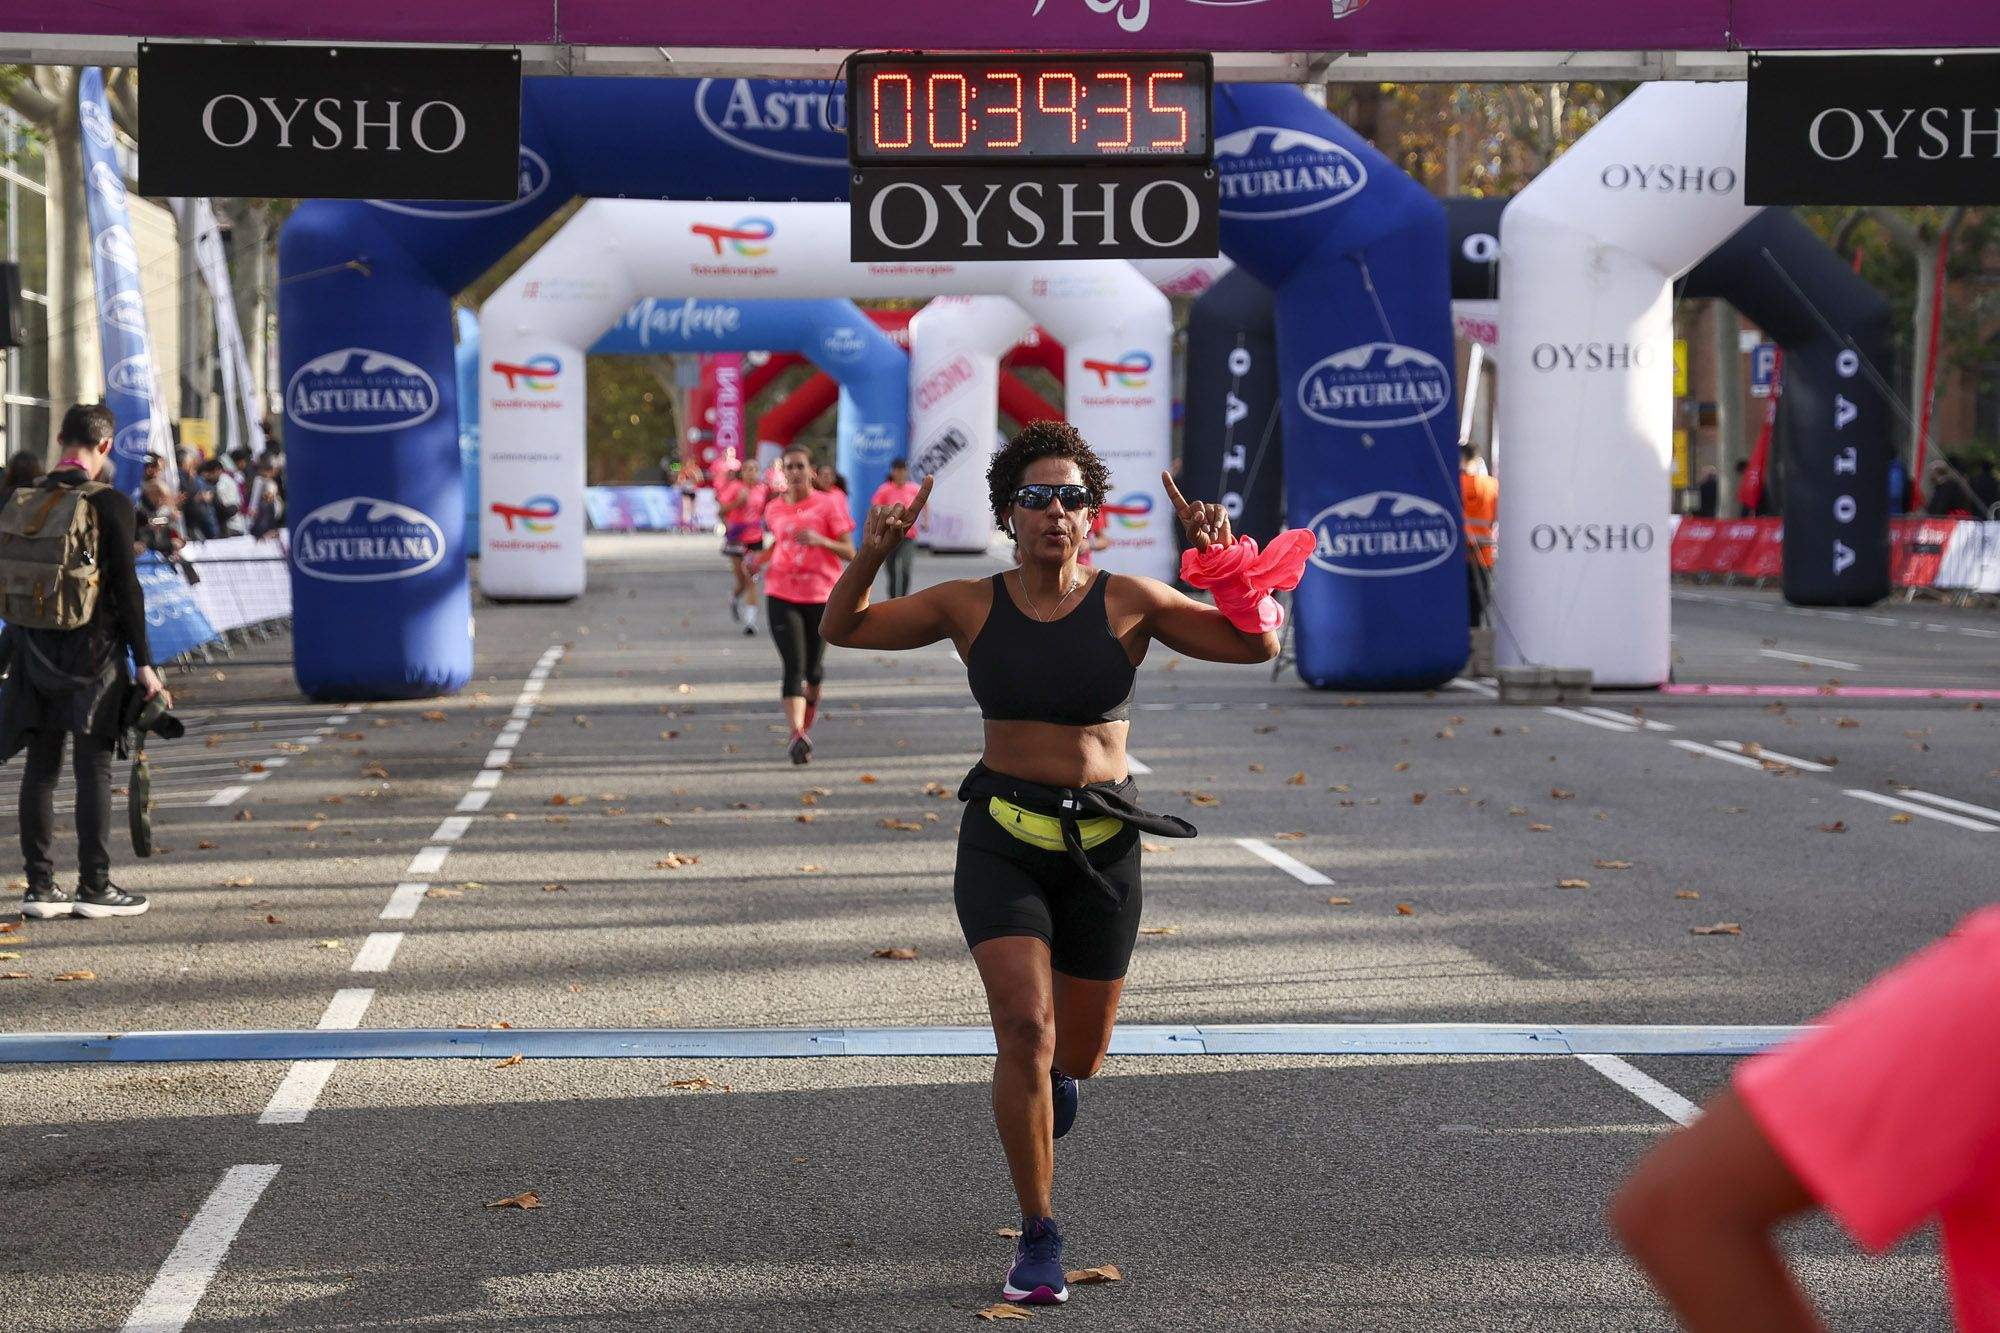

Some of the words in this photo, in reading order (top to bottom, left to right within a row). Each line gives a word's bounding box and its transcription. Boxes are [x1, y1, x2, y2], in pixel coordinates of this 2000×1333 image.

[719, 79, 847, 131] ASTU
[873, 71, 1187, 149] 00:39:35
[202, 94, 466, 153] OYSHO
[1809, 107, 2000, 160] OYSH
[1219, 164, 1354, 199] TURIANA
[1602, 164, 1737, 195] OYSHO
[869, 180, 1200, 249] OYSHO
[1532, 343, 1656, 372] OYSHO
[295, 383, 428, 416] ASTURIANA
[1309, 376, 1444, 410] ASTURIANA
[1221, 347, 1250, 520] OLVO
[1833, 349, 1859, 575] VOLVO
[300, 532, 435, 563] ASTURIANA
[1316, 525, 1449, 558] ASTURIANA
[1530, 522, 1655, 554] OYSHO
